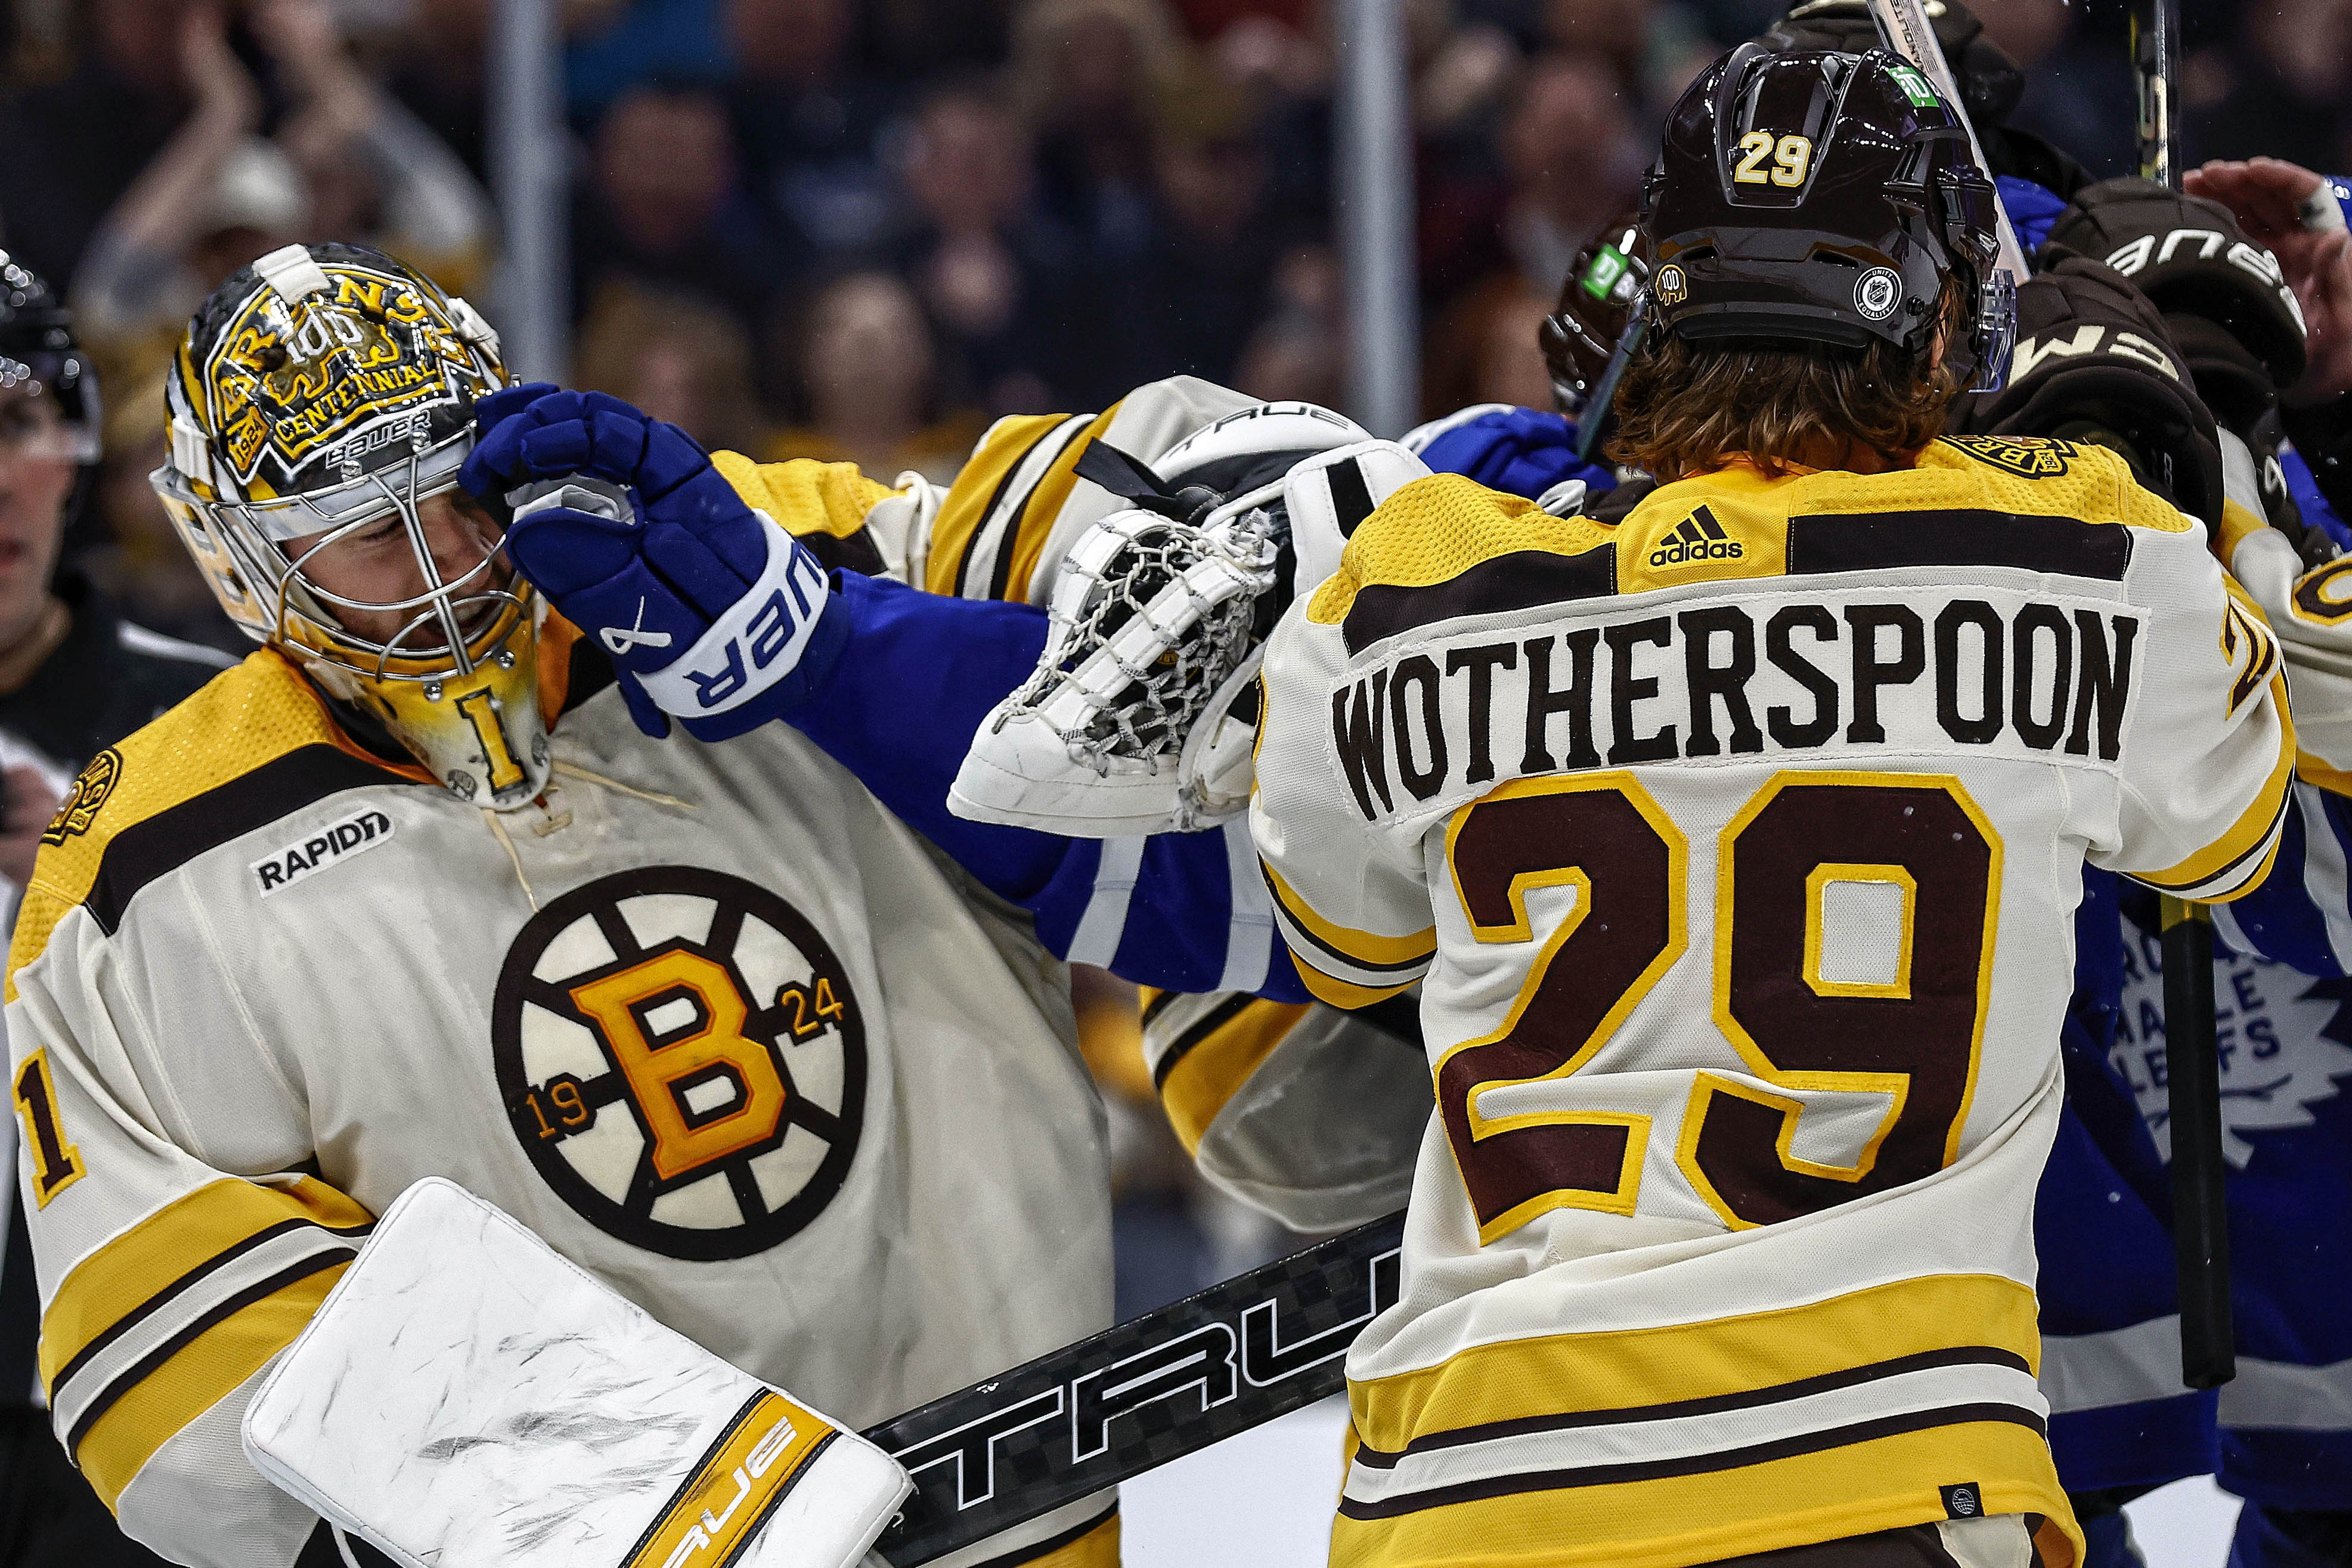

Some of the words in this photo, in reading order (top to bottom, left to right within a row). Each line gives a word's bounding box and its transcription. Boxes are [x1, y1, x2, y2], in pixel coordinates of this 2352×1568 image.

[1734, 132, 1811, 187] 29
[1662, 269, 1679, 290] 100
[1858, 302, 1891, 318] EQUALITY
[1871, 269, 1894, 278] UNITY
[1871, 288, 1884, 299] NHL
[275, 360, 437, 442] CENTENNIAL
[1650, 540, 1743, 566] adidas
[682, 541, 822, 708] UER
[1331, 599, 2139, 822] WOTHERSPOON
[258, 811, 390, 890] RAPID7
[780, 977, 844, 1036] 24
[1431, 769, 2004, 1246] 29
[569, 948, 786, 1180] B
[13, 1046, 86, 1211] 1
[526, 1081, 588, 1139] 19
[893, 1247, 1402, 1512] TRU
[662, 1415, 798, 1568] RUE
